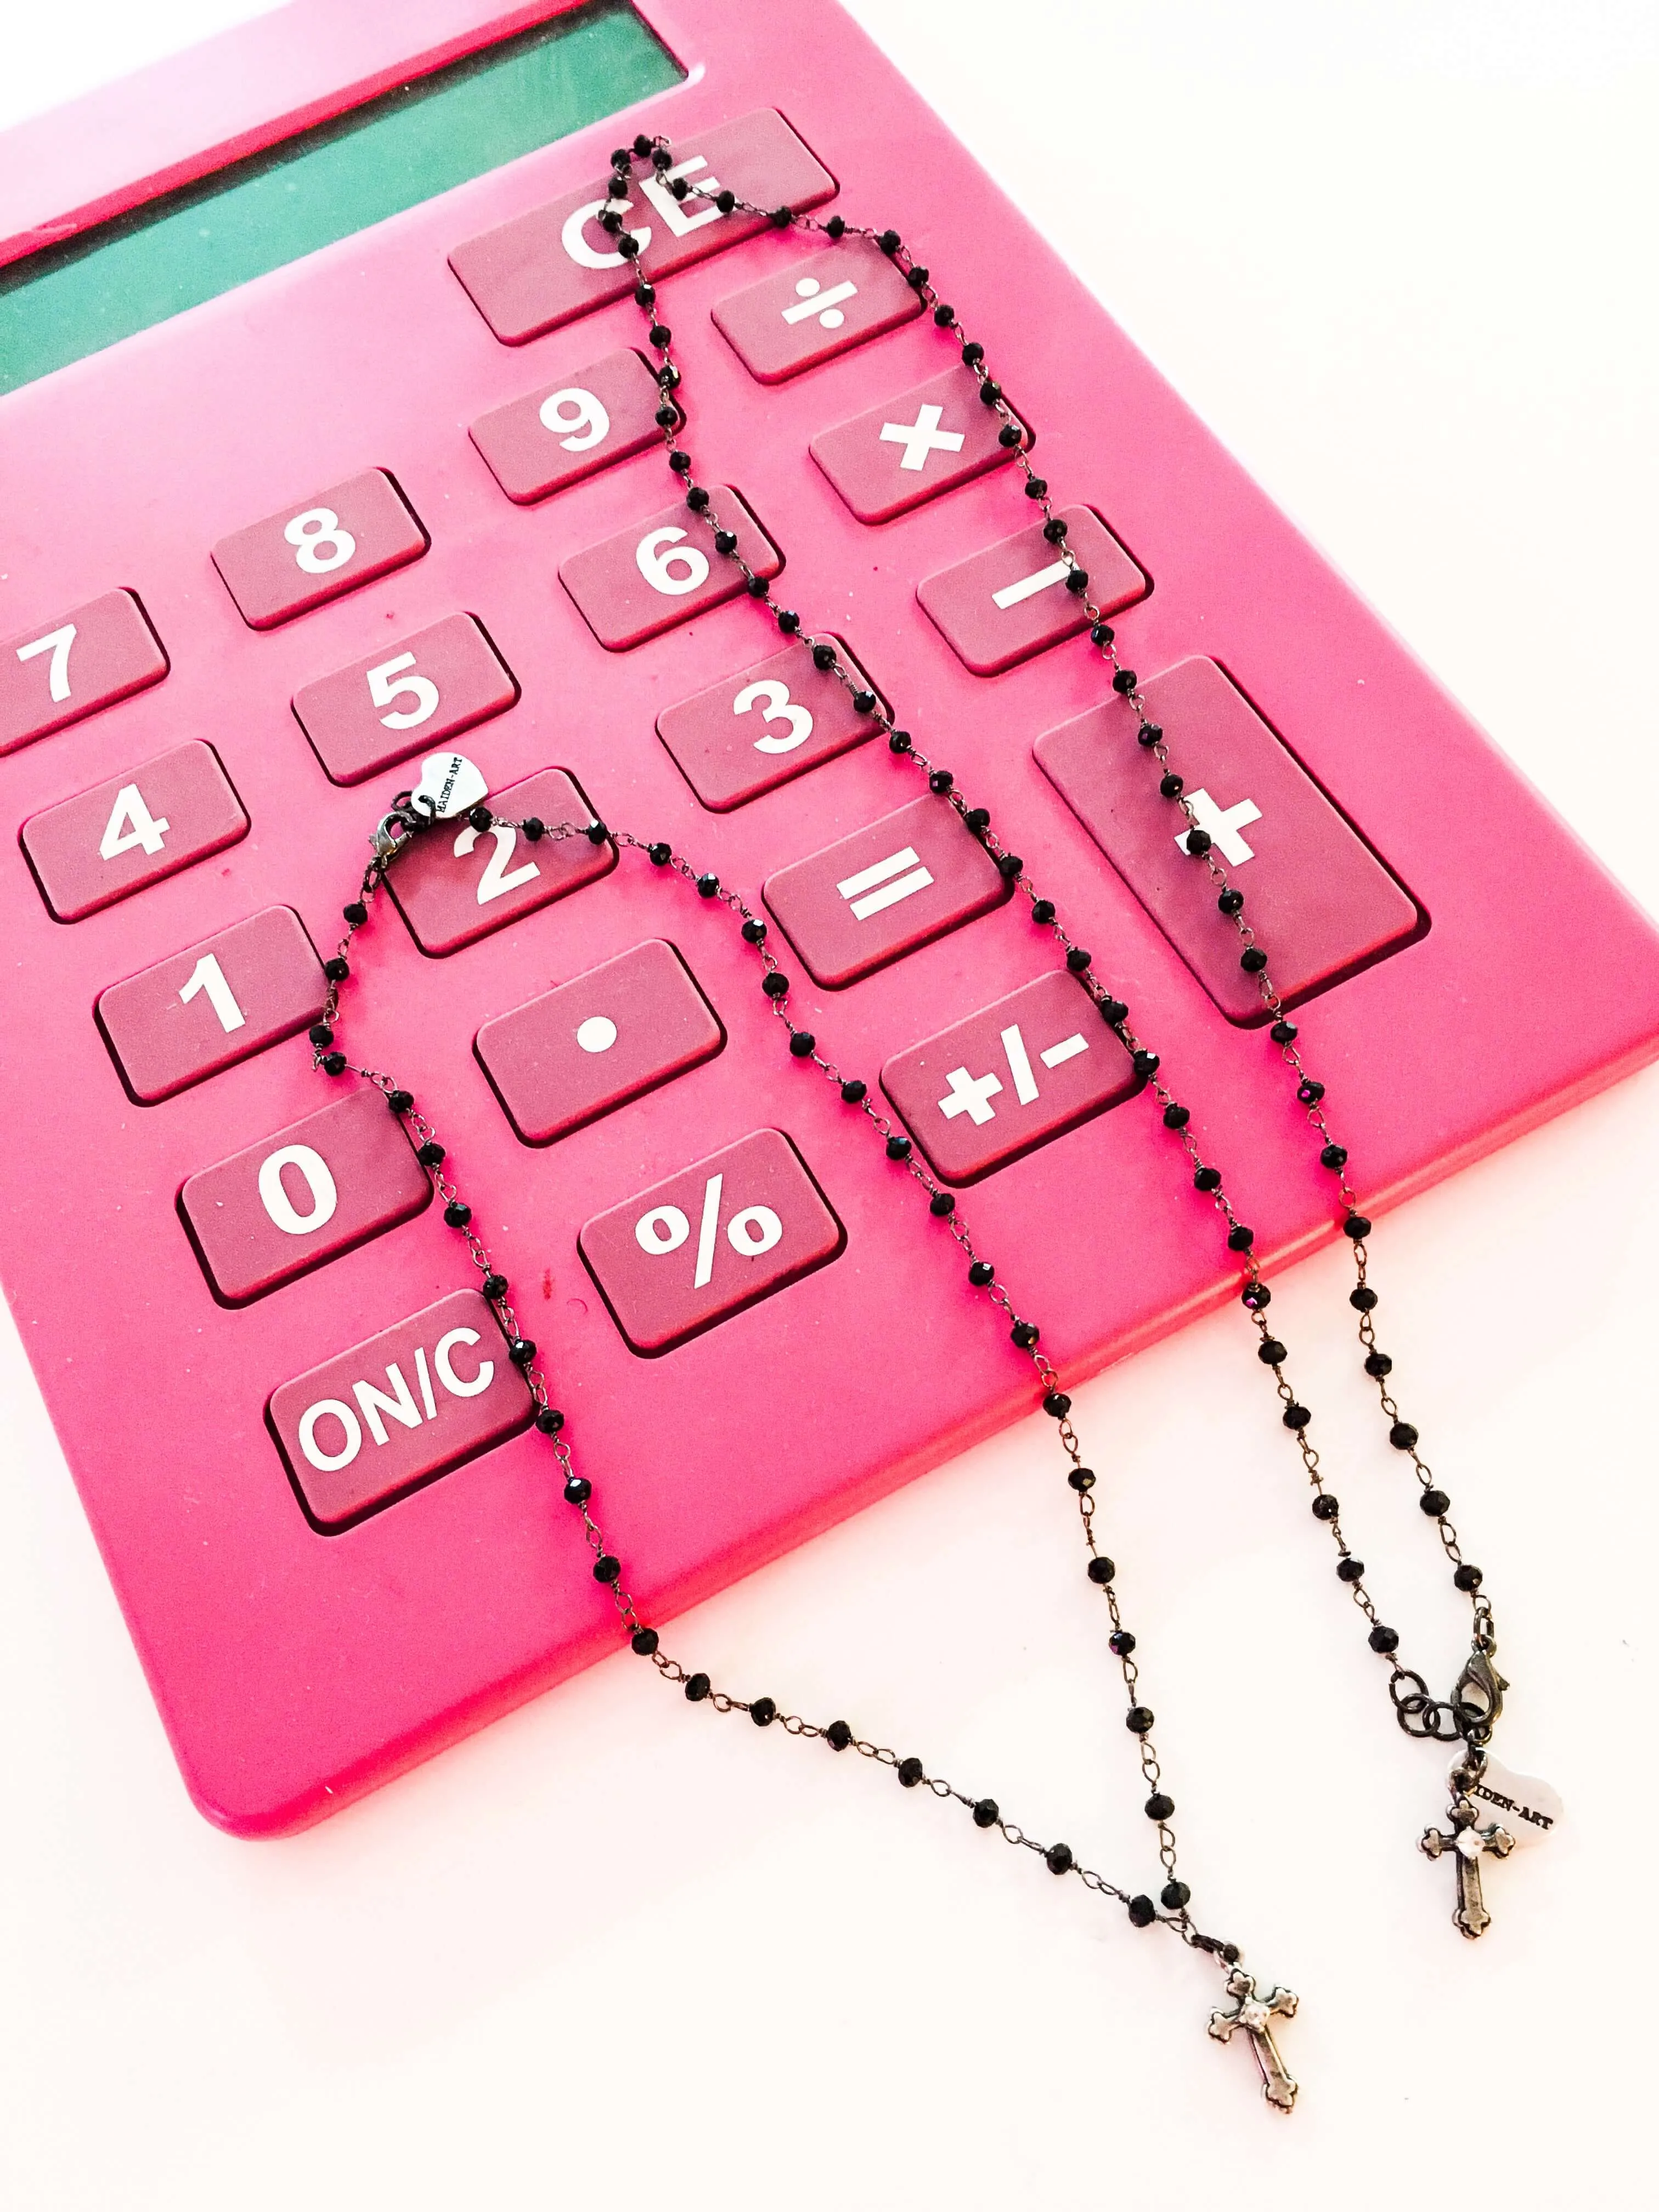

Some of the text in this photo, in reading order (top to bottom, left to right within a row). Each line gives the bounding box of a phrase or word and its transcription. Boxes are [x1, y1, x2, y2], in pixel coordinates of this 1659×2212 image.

[563, 157, 737, 268] CE
[540, 388, 610, 452] 9
[285, 509, 356, 573] 8
[636, 527, 709, 595] 6
[16, 624, 77, 703] 7
[366, 652, 439, 730] 5
[734, 680, 813, 754] 3
[99, 783, 170, 861] 4
[436, 757, 462, 812] MAIDEN-ART
[454, 823, 540, 905] 2
[179, 953, 246, 1032] 1
[258, 1144, 337, 1234] 0
[635, 1173, 783, 1289] %
[298, 1328, 494, 1471] ON/C
[1473, 1784, 1554, 1830] IDEN-ART
